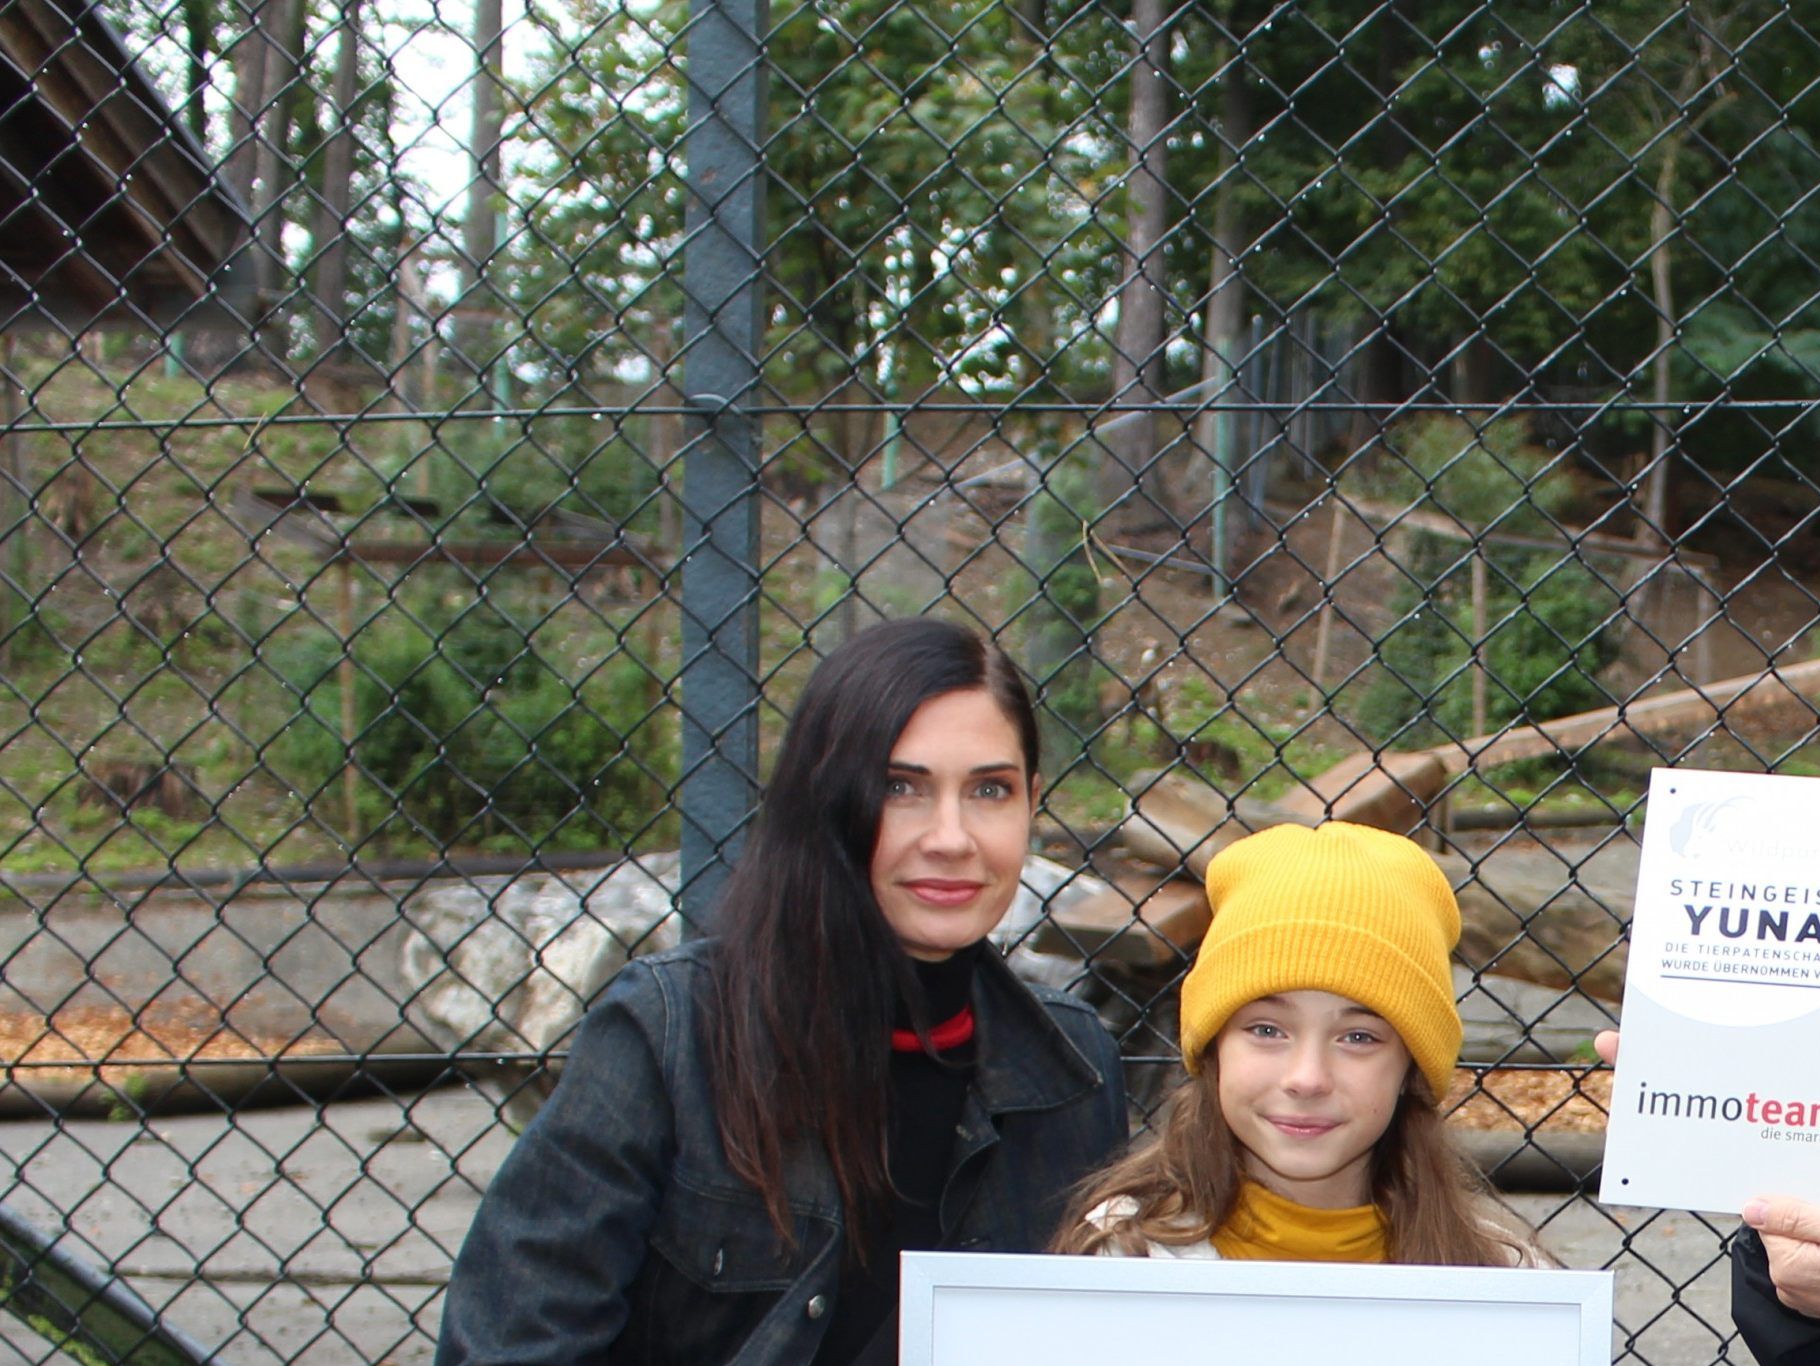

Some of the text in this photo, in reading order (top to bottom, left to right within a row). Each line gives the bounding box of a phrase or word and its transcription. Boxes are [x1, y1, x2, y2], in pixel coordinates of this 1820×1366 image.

[1665, 942, 1688, 954] DIE
[1661, 959, 1709, 972] WURDE
[1713, 960, 1810, 979] ÜBERNOMMEN
[1760, 1127, 1782, 1141] die
